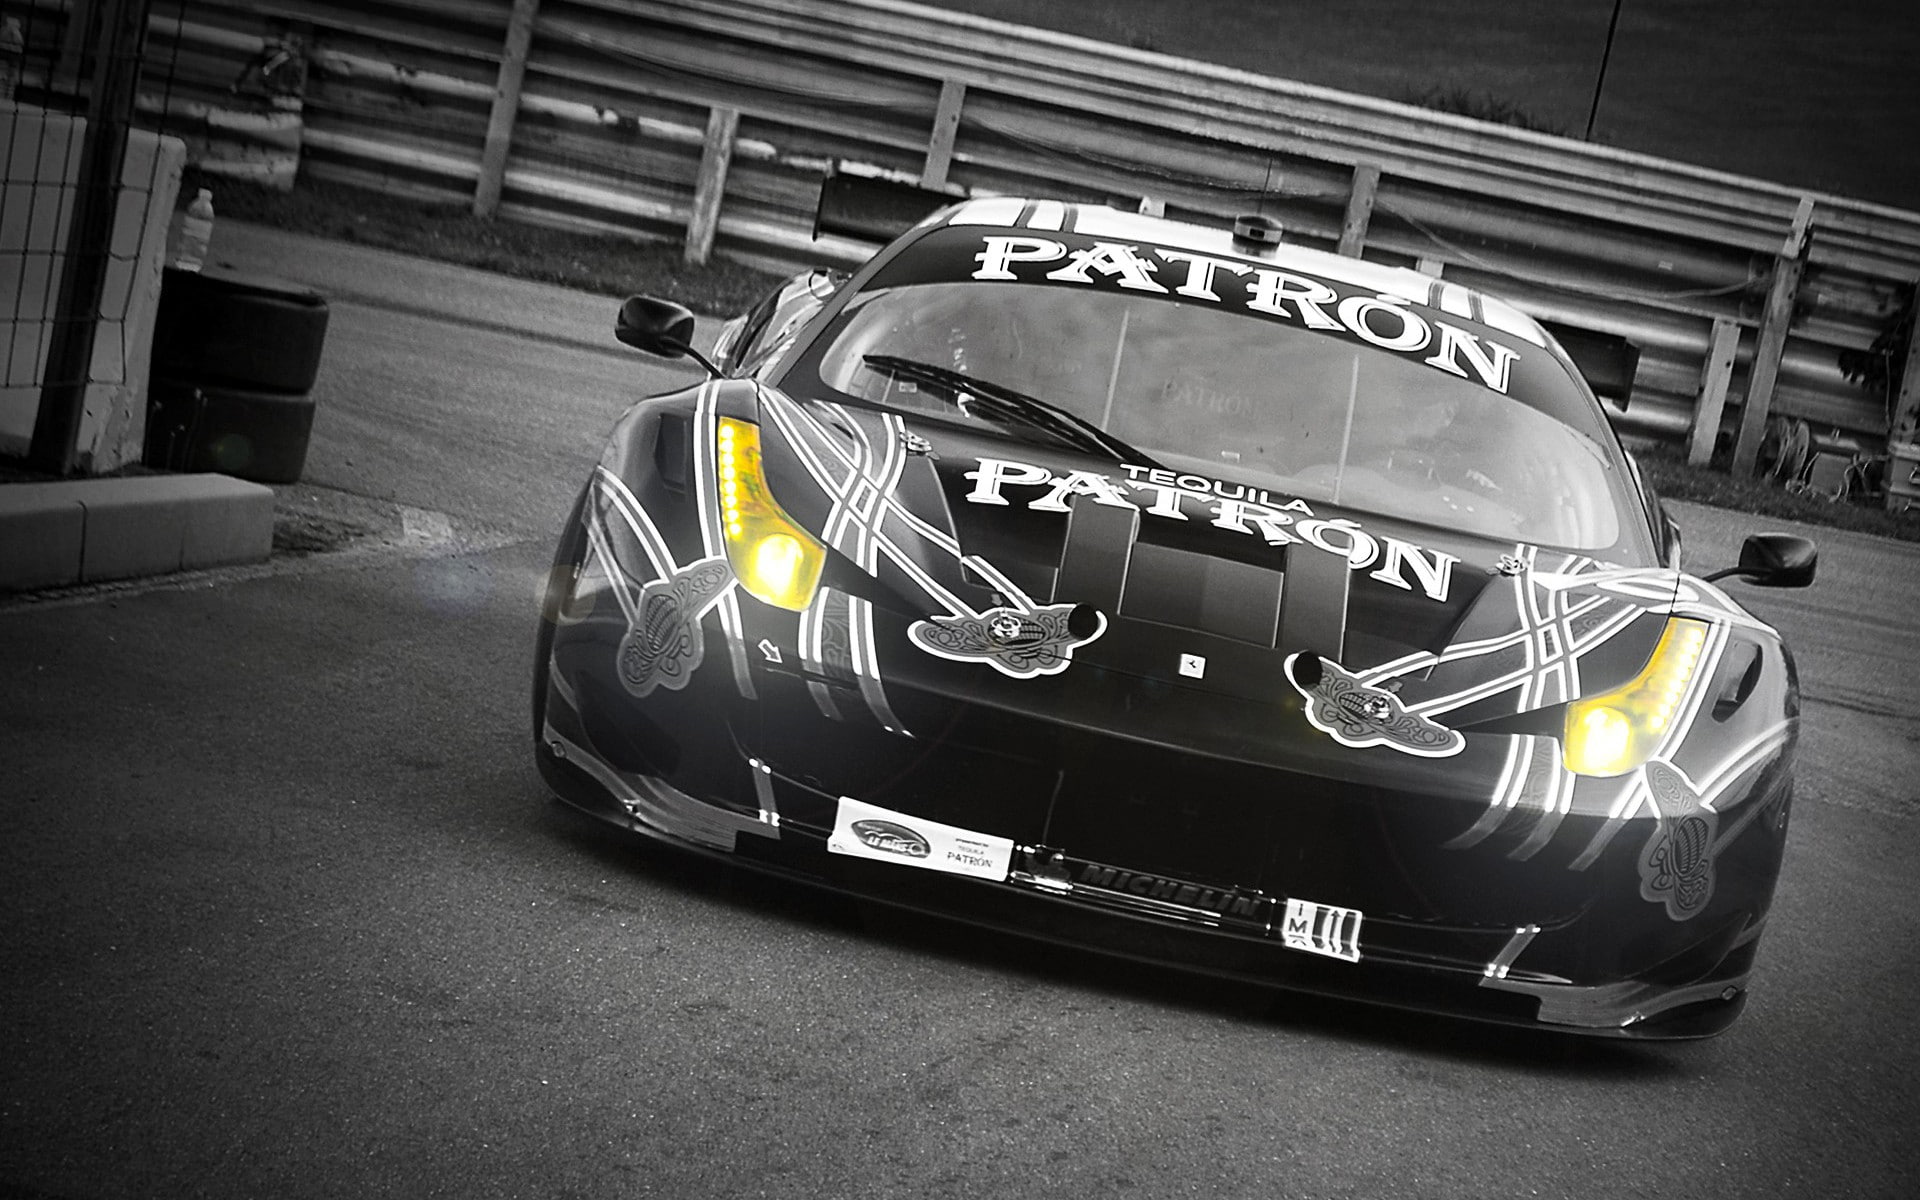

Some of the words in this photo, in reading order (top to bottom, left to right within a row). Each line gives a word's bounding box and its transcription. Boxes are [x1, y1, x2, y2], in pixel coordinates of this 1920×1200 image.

[972, 235, 1521, 395] PATRÓN
[964, 457, 1462, 603] PATRÓN
[1119, 463, 1315, 517] TEQUILA
[1079, 864, 1262, 916] MICHELIN
